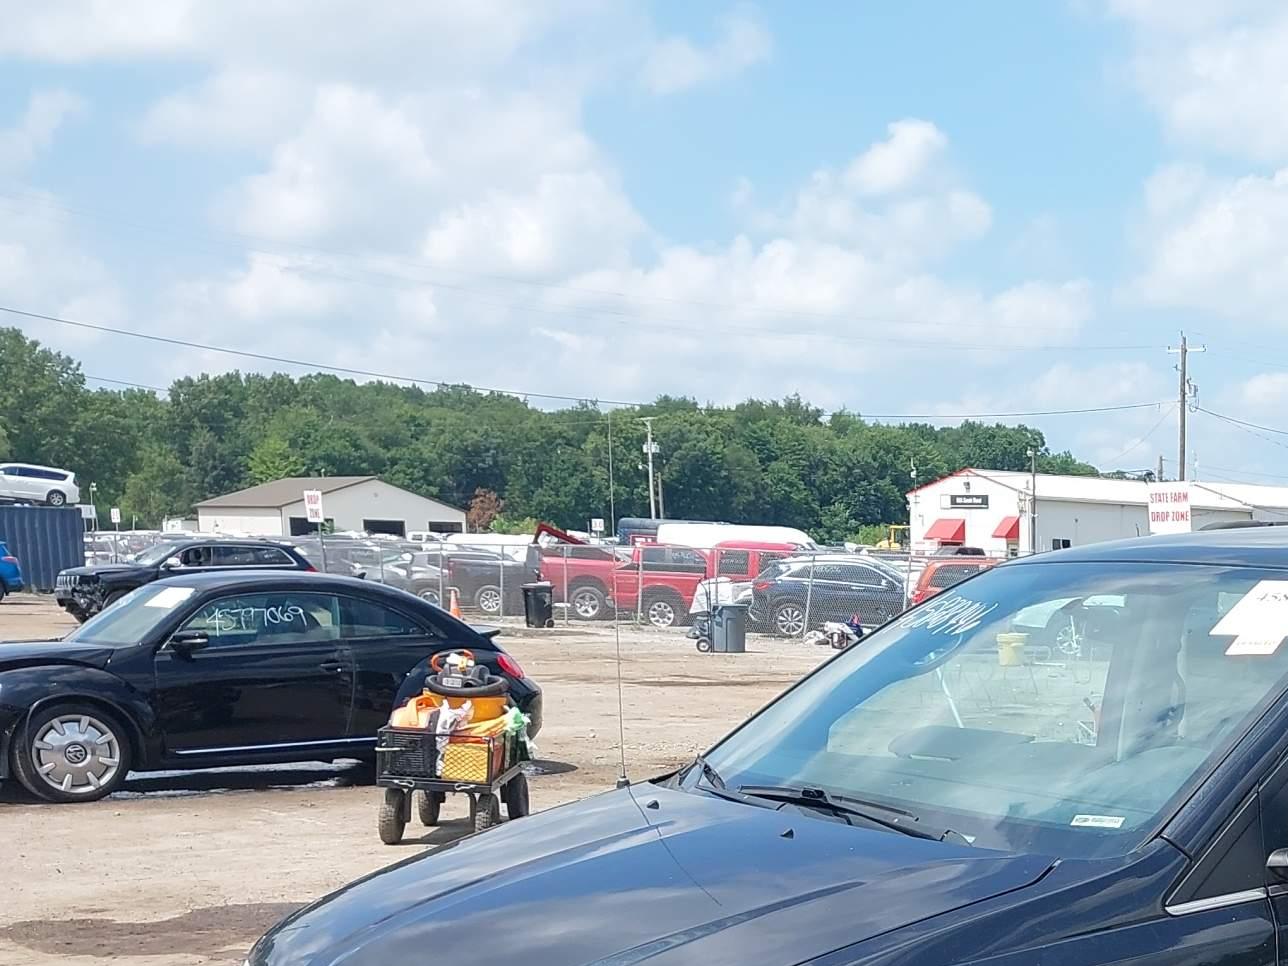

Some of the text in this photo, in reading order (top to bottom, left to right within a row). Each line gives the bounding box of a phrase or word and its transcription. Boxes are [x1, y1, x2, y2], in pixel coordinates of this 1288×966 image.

[1150, 491, 1188, 503] STATE FARM
[1151, 511, 1189, 522] DROP ZONE
[206, 606, 307, 637] 45797069
